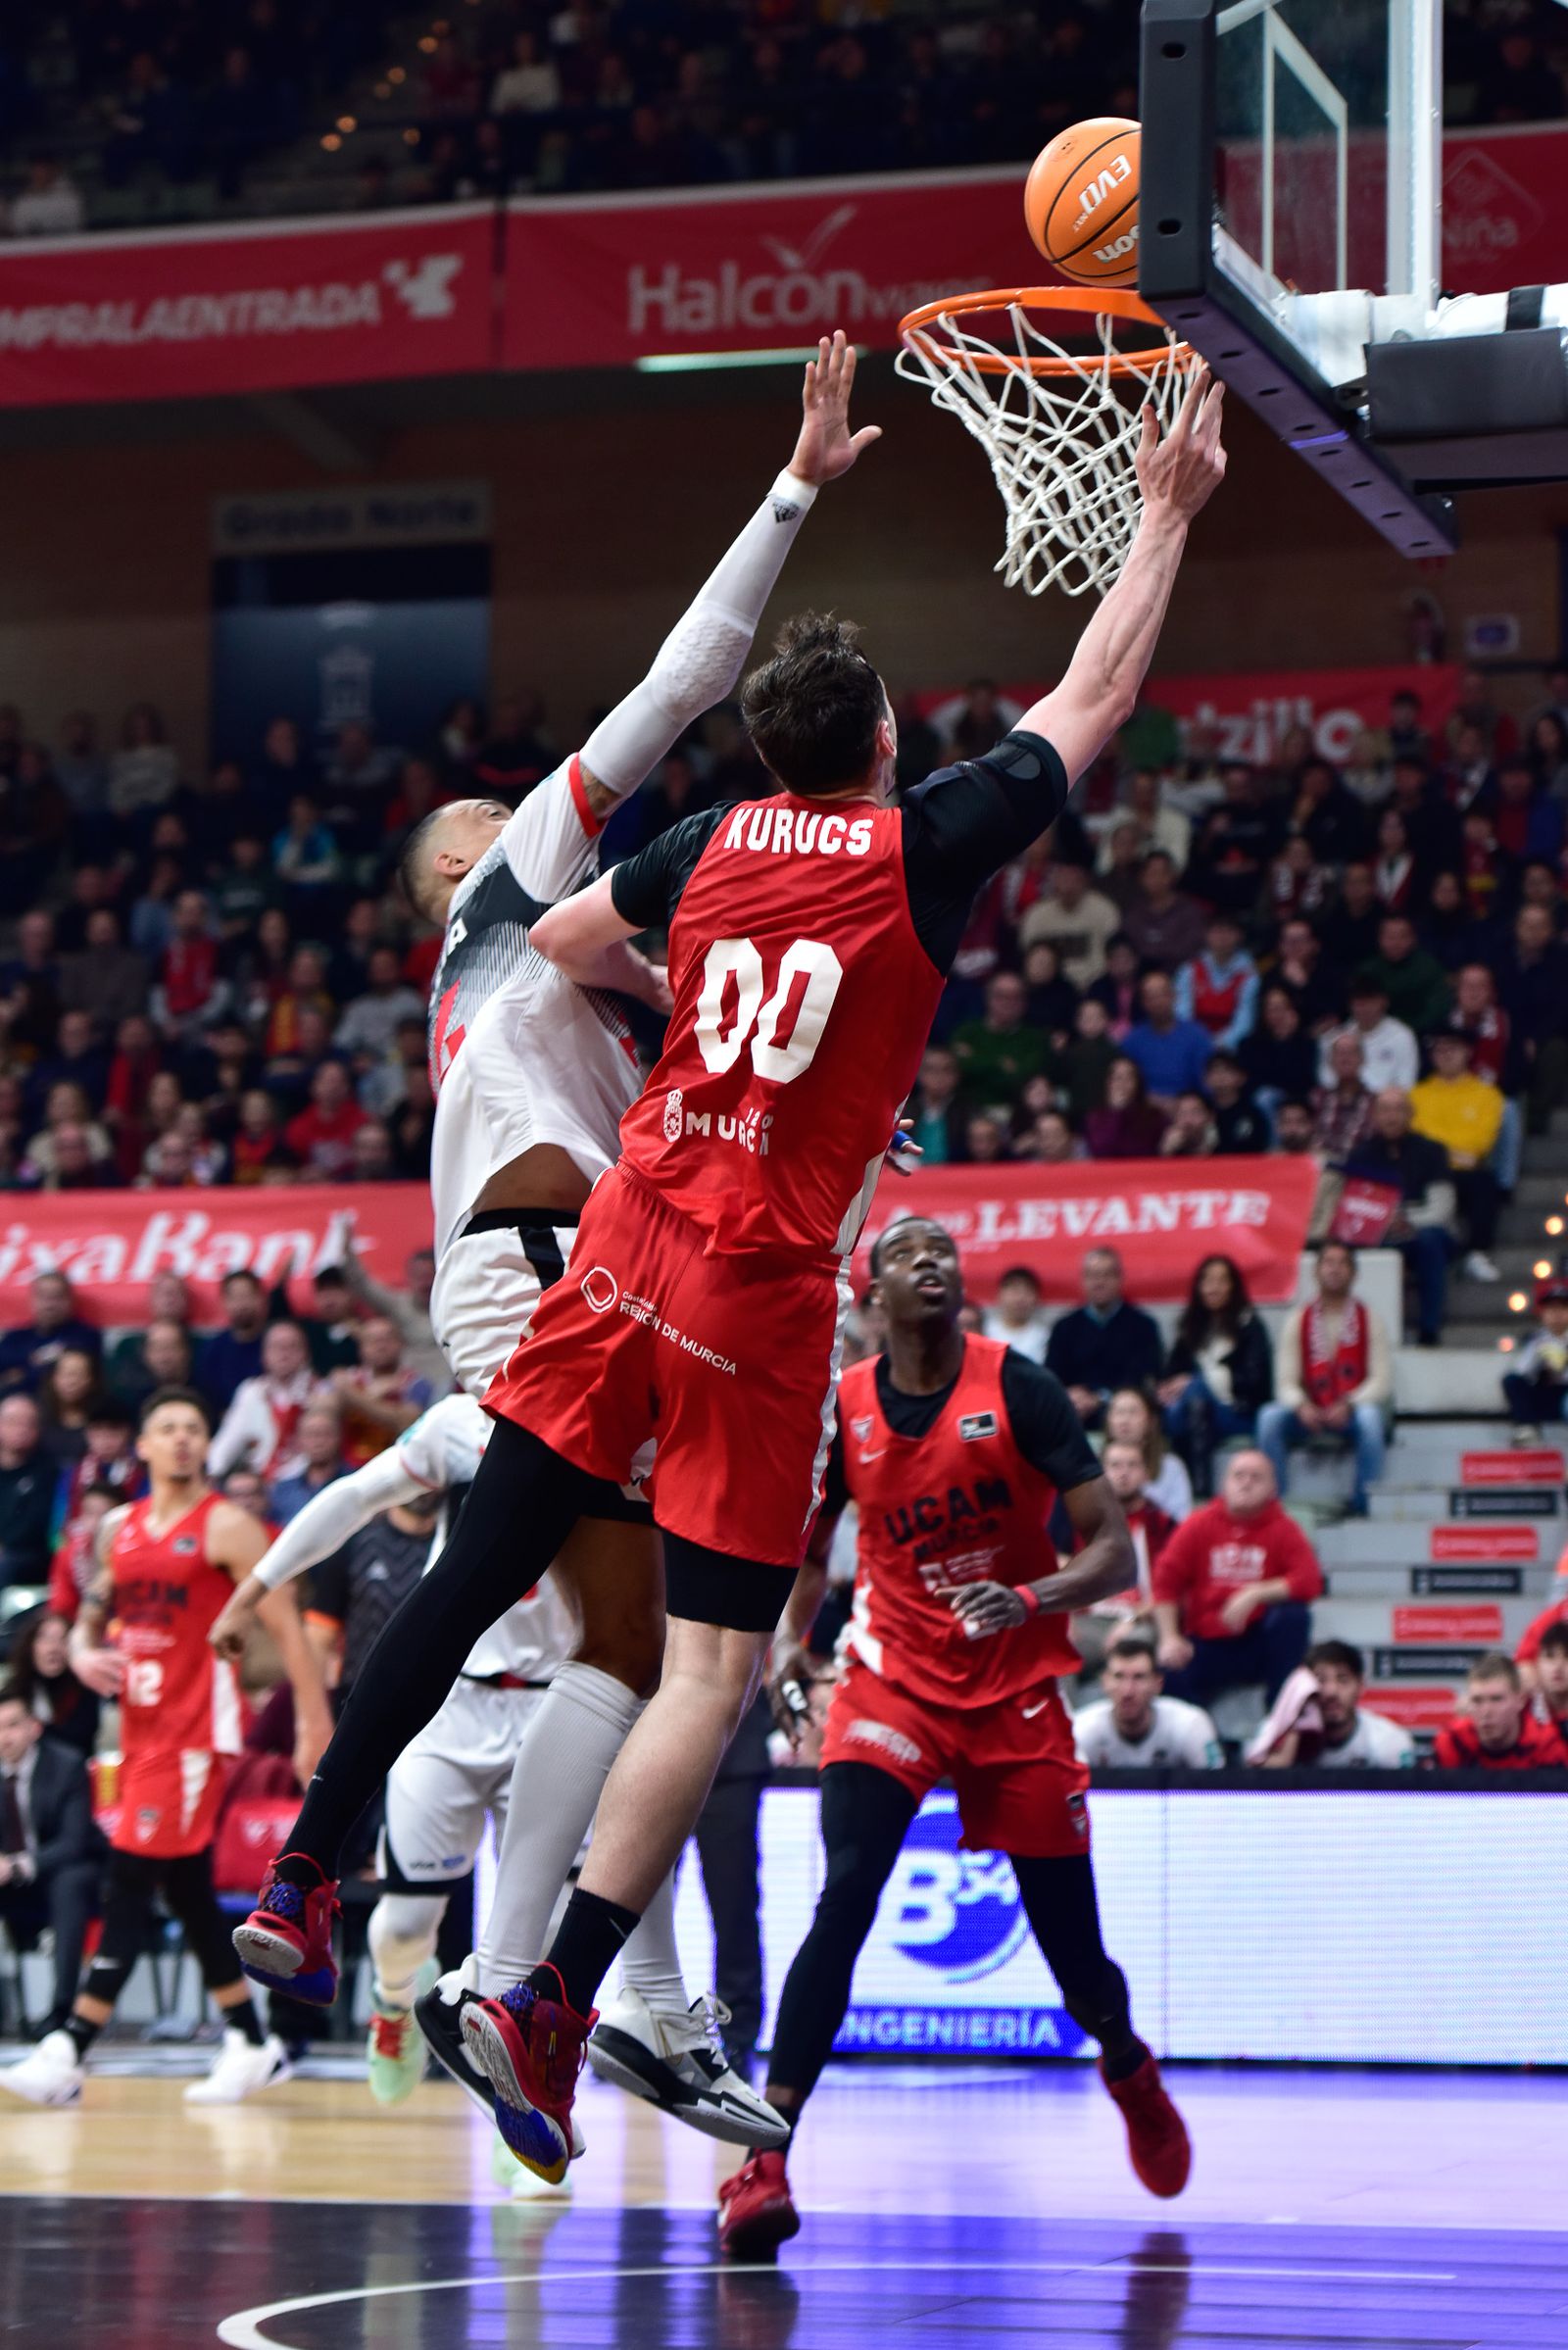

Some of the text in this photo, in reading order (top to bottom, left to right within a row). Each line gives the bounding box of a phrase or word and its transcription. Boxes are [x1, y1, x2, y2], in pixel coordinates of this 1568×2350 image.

[1079, 154, 1132, 215] EVO
[724, 808, 873, 856] KURUCS
[694, 937, 843, 1084] 00
[979, 1189, 1271, 1243] LEVANTE
[662, 1323, 680, 1343] DE
[680, 1335, 737, 1375] MURCIA
[885, 1477, 1013, 1545] UCAM
